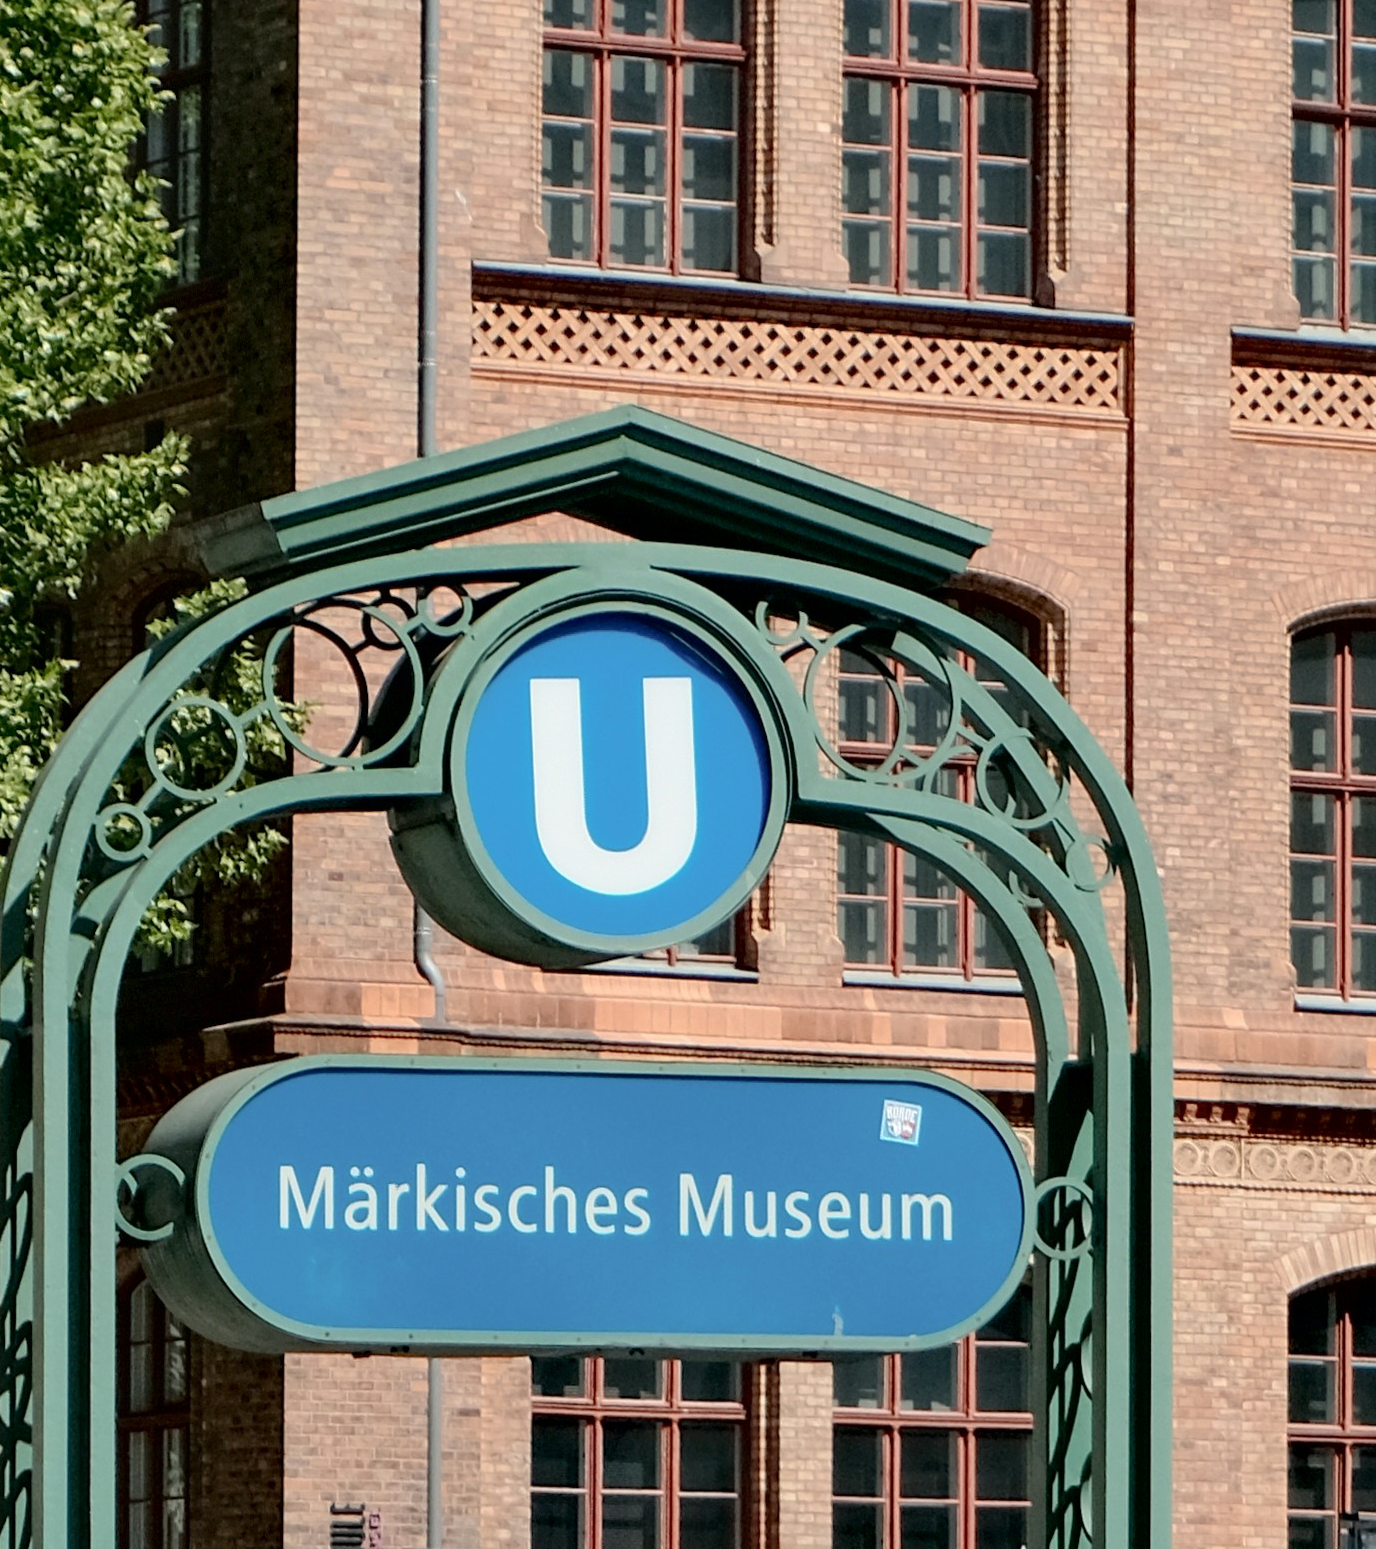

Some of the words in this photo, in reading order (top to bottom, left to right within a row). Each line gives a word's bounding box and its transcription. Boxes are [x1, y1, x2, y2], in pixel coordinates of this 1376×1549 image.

[529, 677, 698, 896] U
[278, 1162, 653, 1237] Märkisches
[678, 1172, 954, 1242] Museum
